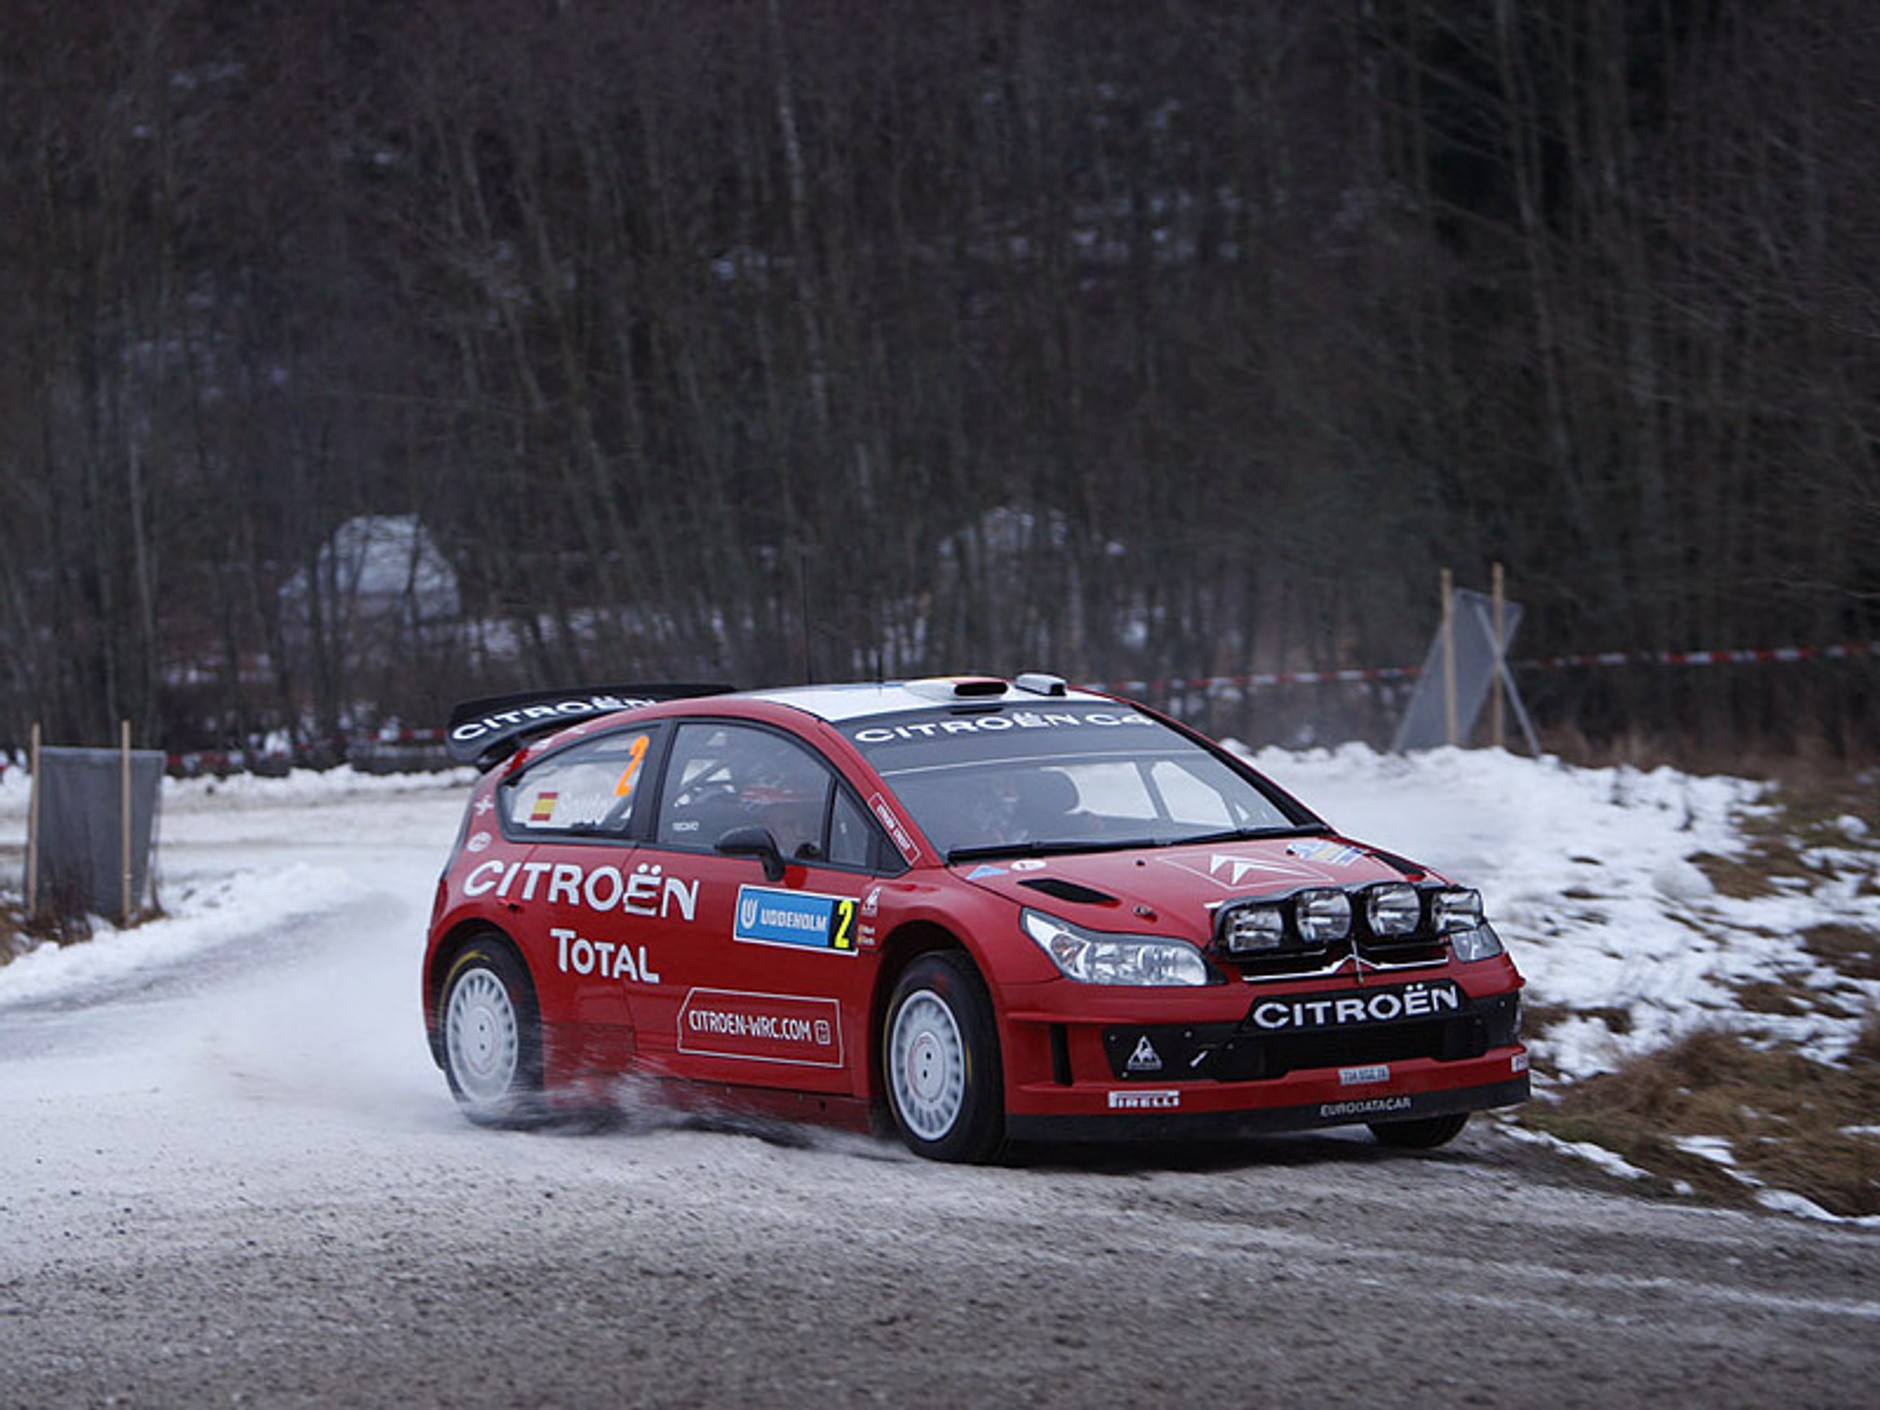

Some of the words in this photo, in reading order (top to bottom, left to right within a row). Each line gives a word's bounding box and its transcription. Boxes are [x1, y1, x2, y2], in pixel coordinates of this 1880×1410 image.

[855, 712, 1081, 742] CITROËN
[615, 736, 649, 796] 2
[463, 860, 699, 920] CITROËN
[761, 908, 828, 932] UDDEHOLM
[834, 900, 852, 948] 2
[688, 1009, 813, 1042] CITROEN-WRC.COM
[1252, 983, 1458, 1030] CITROËN
[1108, 1090, 1180, 1109] PIRELLI
